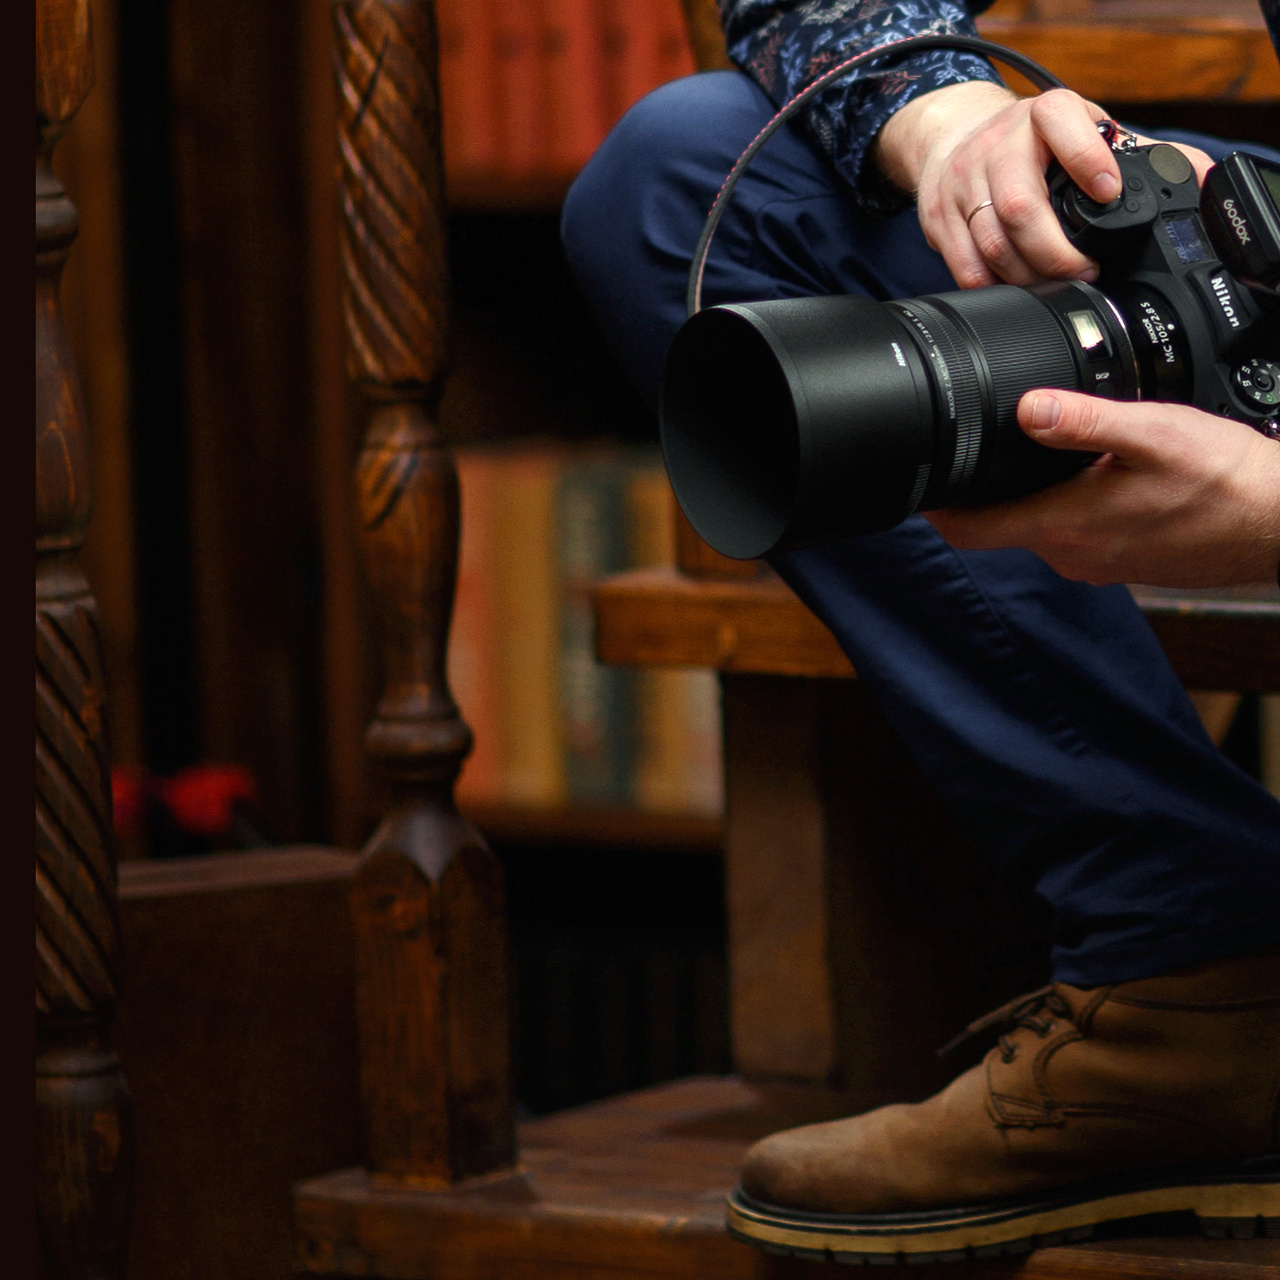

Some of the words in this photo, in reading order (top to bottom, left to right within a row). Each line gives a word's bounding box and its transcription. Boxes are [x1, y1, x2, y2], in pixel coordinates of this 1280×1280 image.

[1223, 199, 1251, 246] Godox
[1211, 277, 1240, 328] Nikon
[1145, 307, 1170, 343] 105/2.8
[891, 342, 906, 367] Nikon
[1163, 344, 1175, 363] MC
